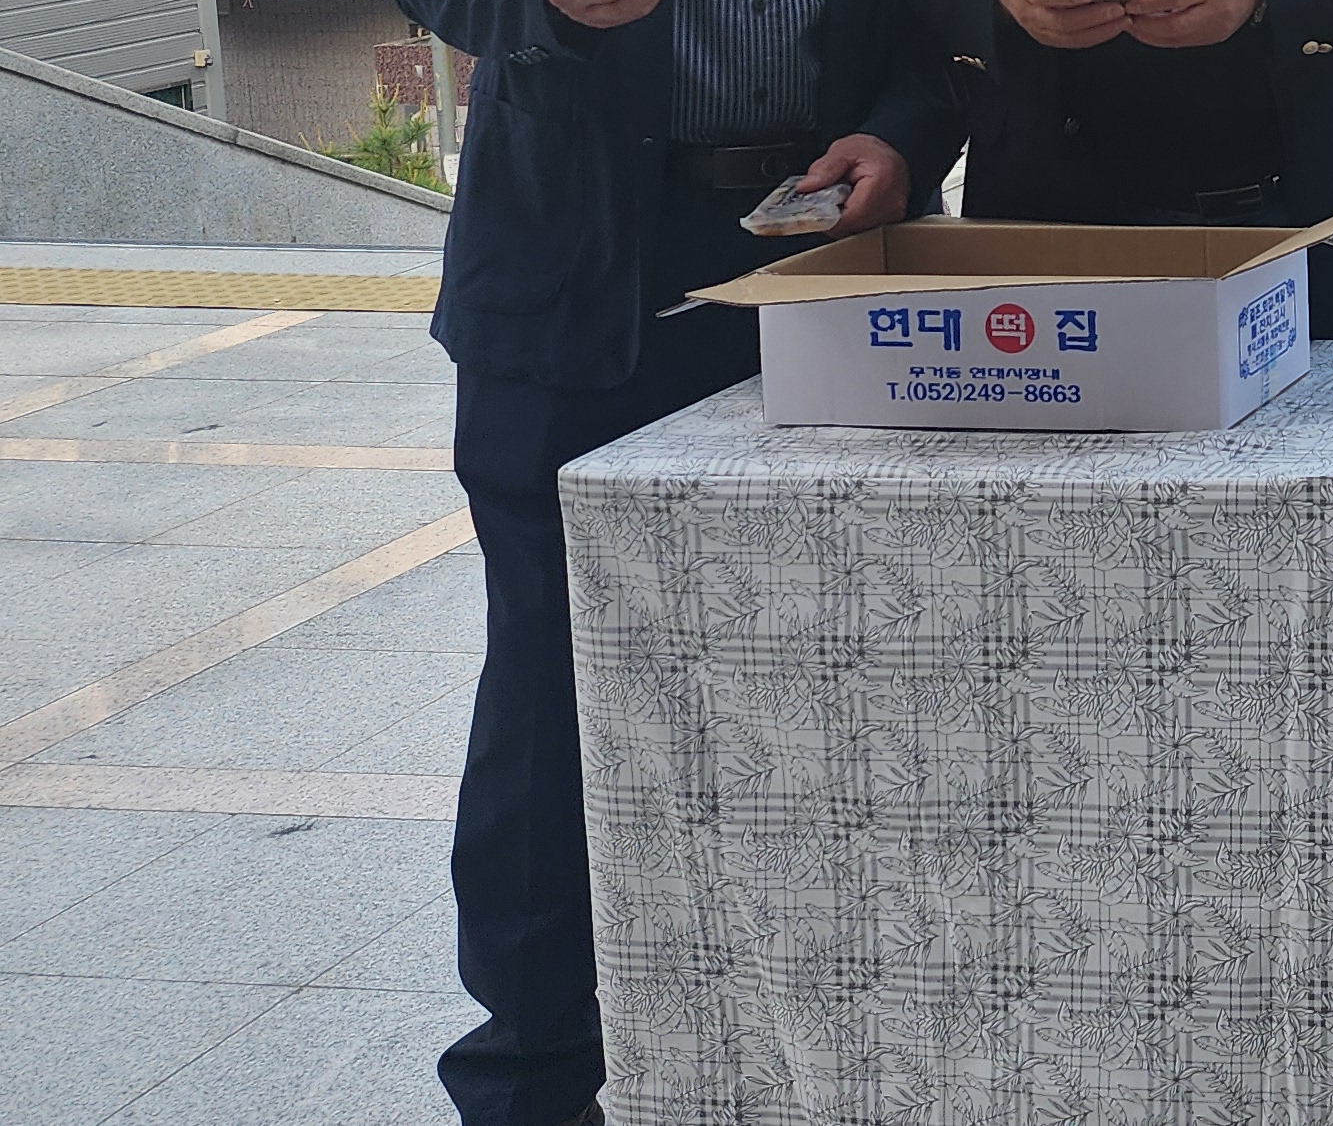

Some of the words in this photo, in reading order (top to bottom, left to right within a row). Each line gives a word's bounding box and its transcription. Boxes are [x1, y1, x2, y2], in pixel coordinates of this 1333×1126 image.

[868, 308, 962, 351] 현대
[989, 312, 1028, 347] 떡
[1055, 310, 1098, 351] 집
[909, 366, 961, 379] 무거동
[969, 366, 1061, 380] 현대시장내
[886, 381, 1081, 403] T.(052)249-8663
